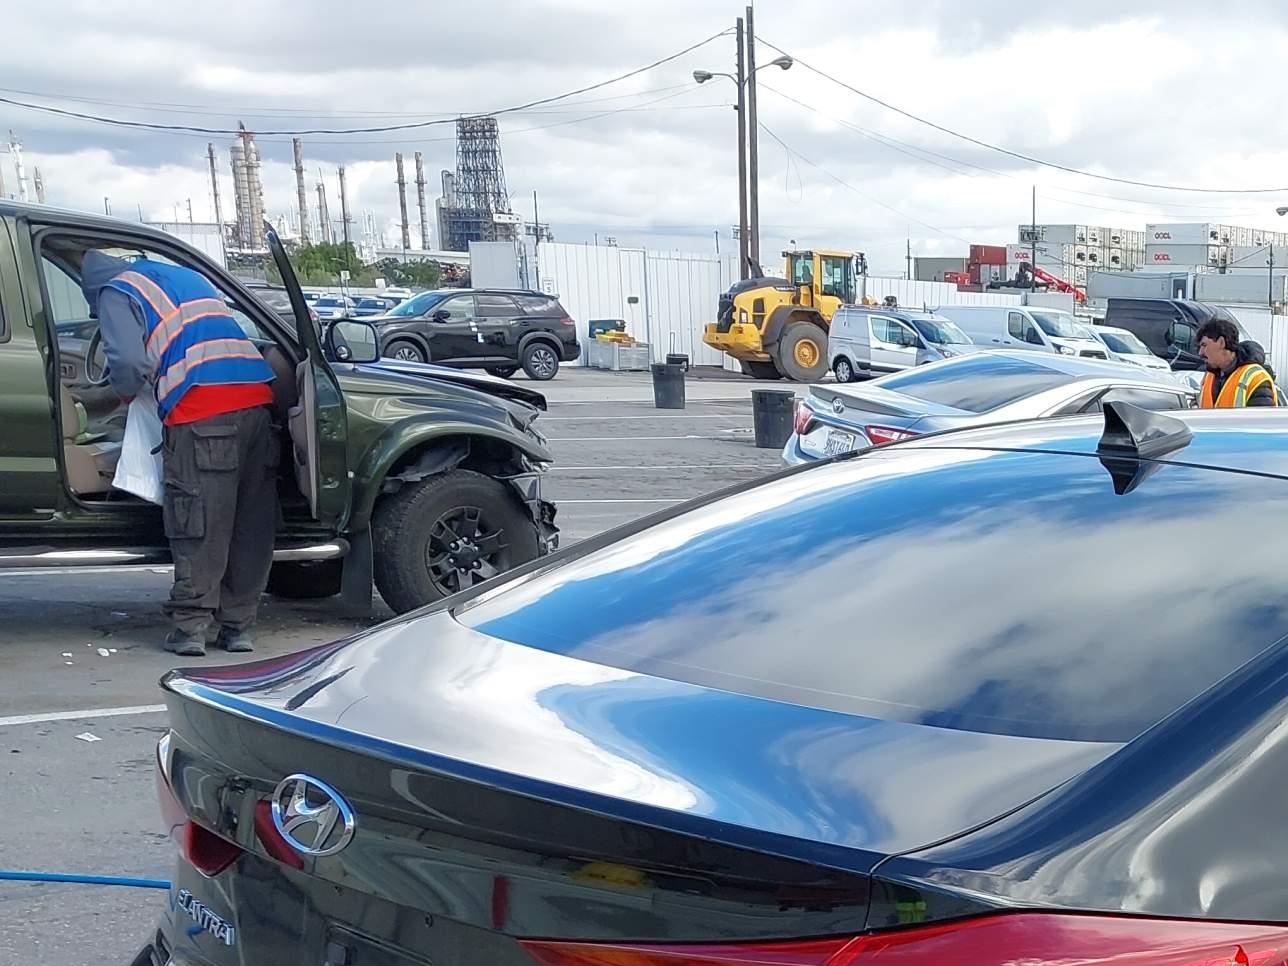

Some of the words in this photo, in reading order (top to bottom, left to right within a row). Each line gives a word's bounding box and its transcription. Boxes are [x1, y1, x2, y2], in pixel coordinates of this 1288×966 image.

[1154, 232, 1172, 240] OOCL
[1014, 252, 1030, 260] OOCL
[1154, 253, 1171, 261] OOCL
[178, 889, 235, 945] ELANTRA
